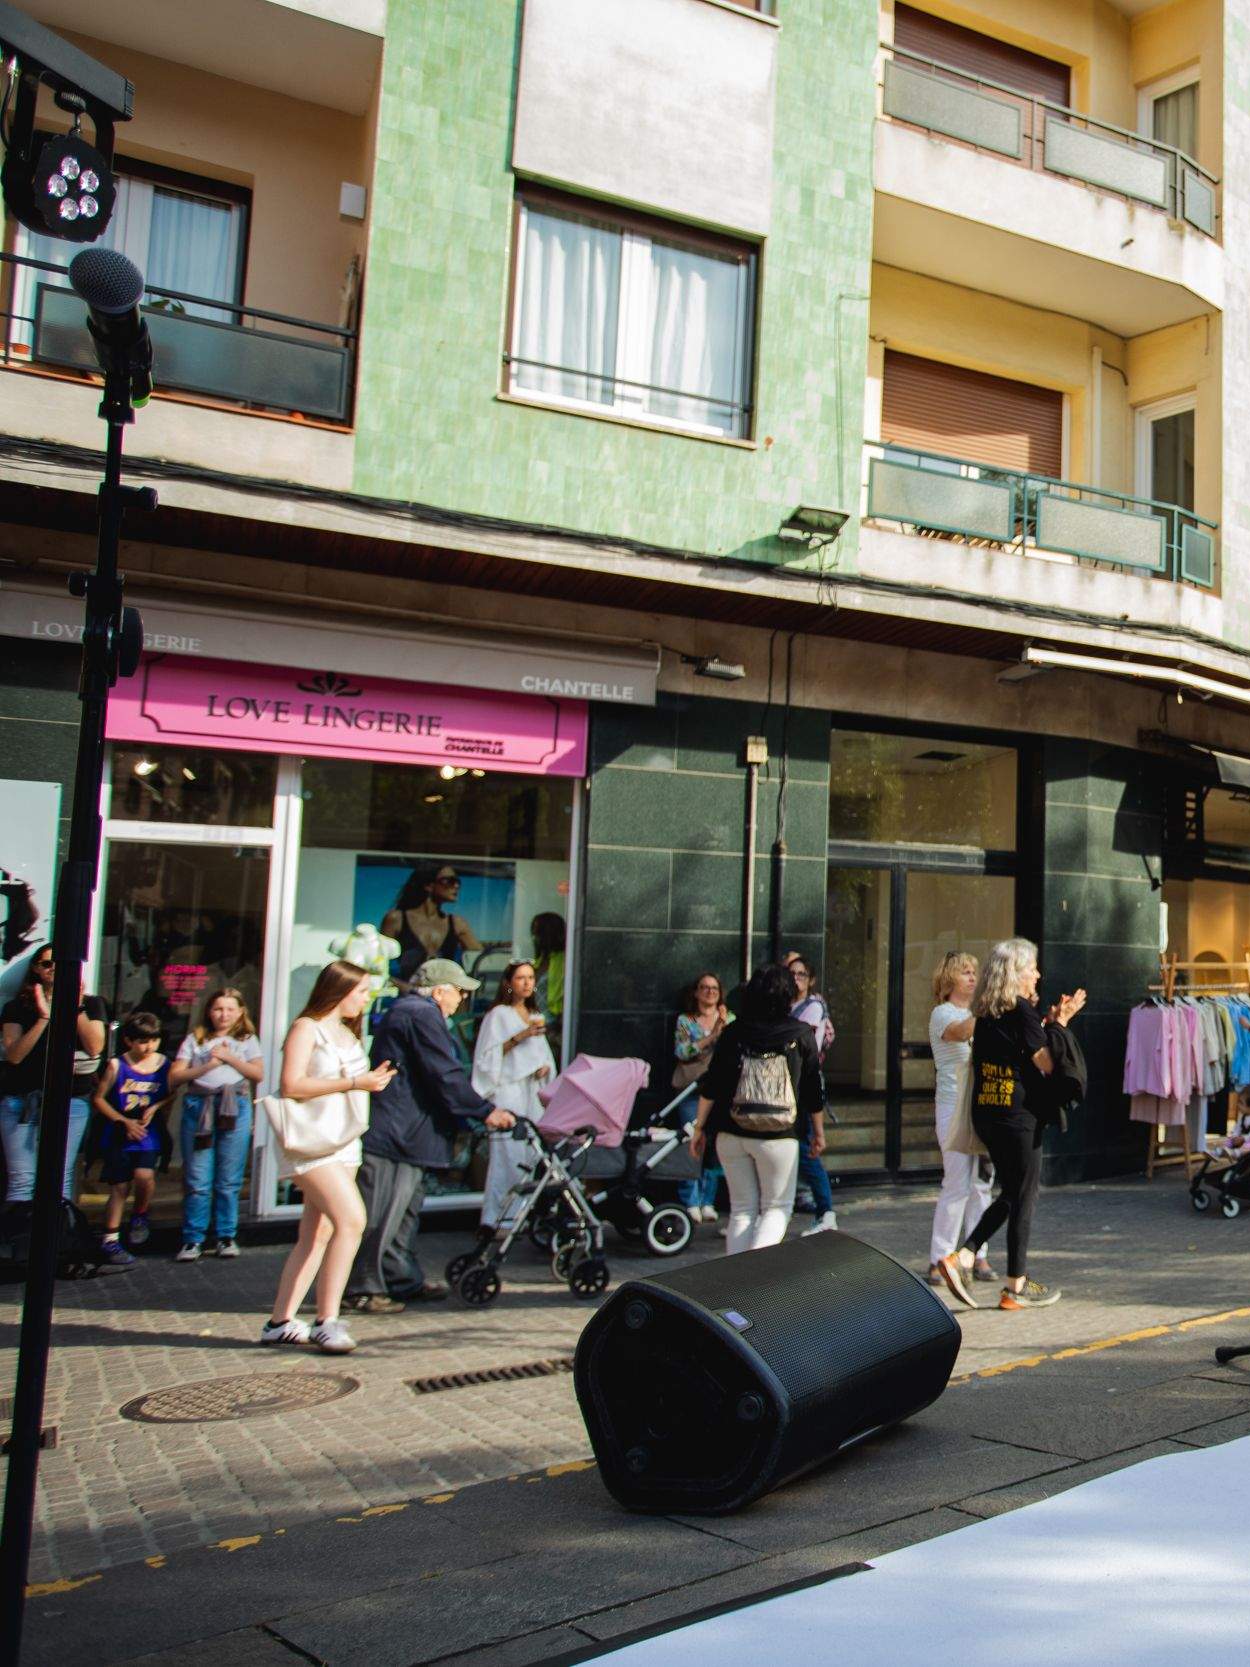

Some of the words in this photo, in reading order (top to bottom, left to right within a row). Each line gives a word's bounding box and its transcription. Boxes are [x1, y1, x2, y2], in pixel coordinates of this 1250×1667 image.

[143, 633, 203, 652] GERIE
[520, 675, 635, 700] CHANTELLE
[207, 694, 291, 724] LOVE
[302, 703, 443, 737] LINGERIE
